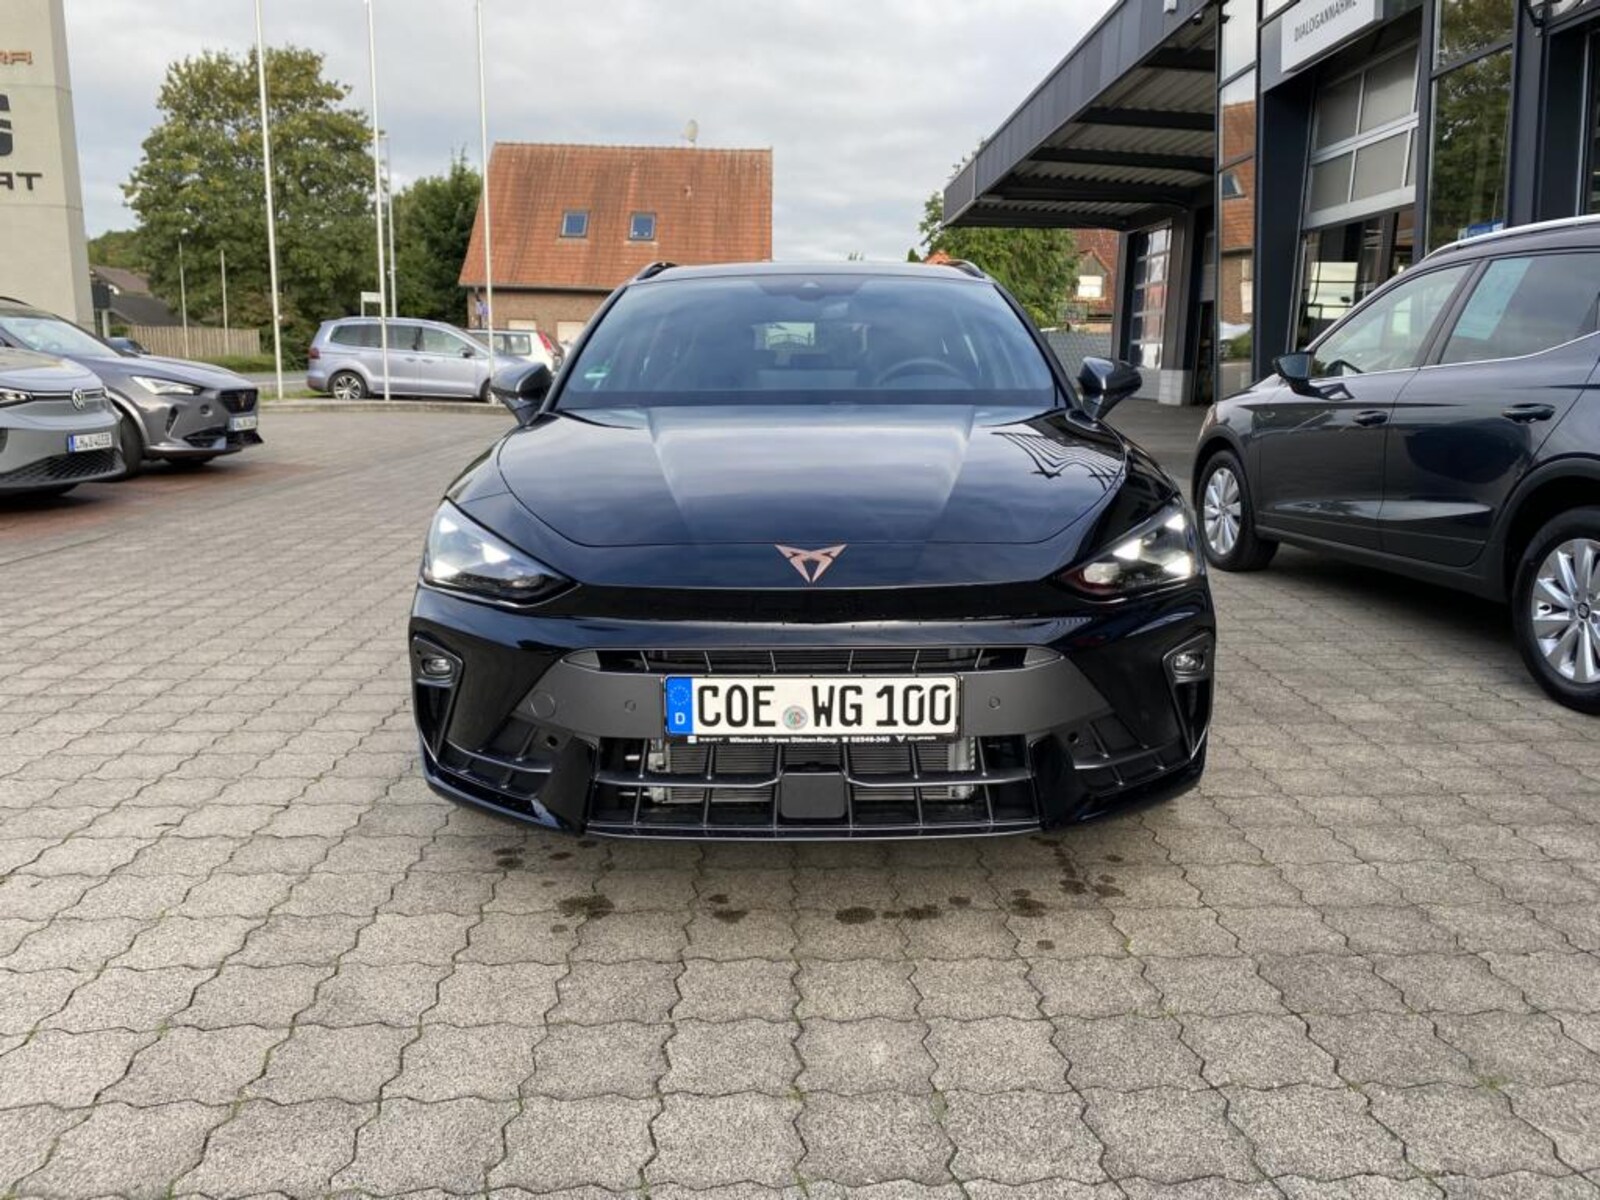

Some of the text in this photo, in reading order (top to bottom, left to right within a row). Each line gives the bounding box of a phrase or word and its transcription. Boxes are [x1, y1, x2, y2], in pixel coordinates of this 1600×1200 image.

[674, 712, 686, 725] D
[697, 684, 951, 727] COE WG 100
